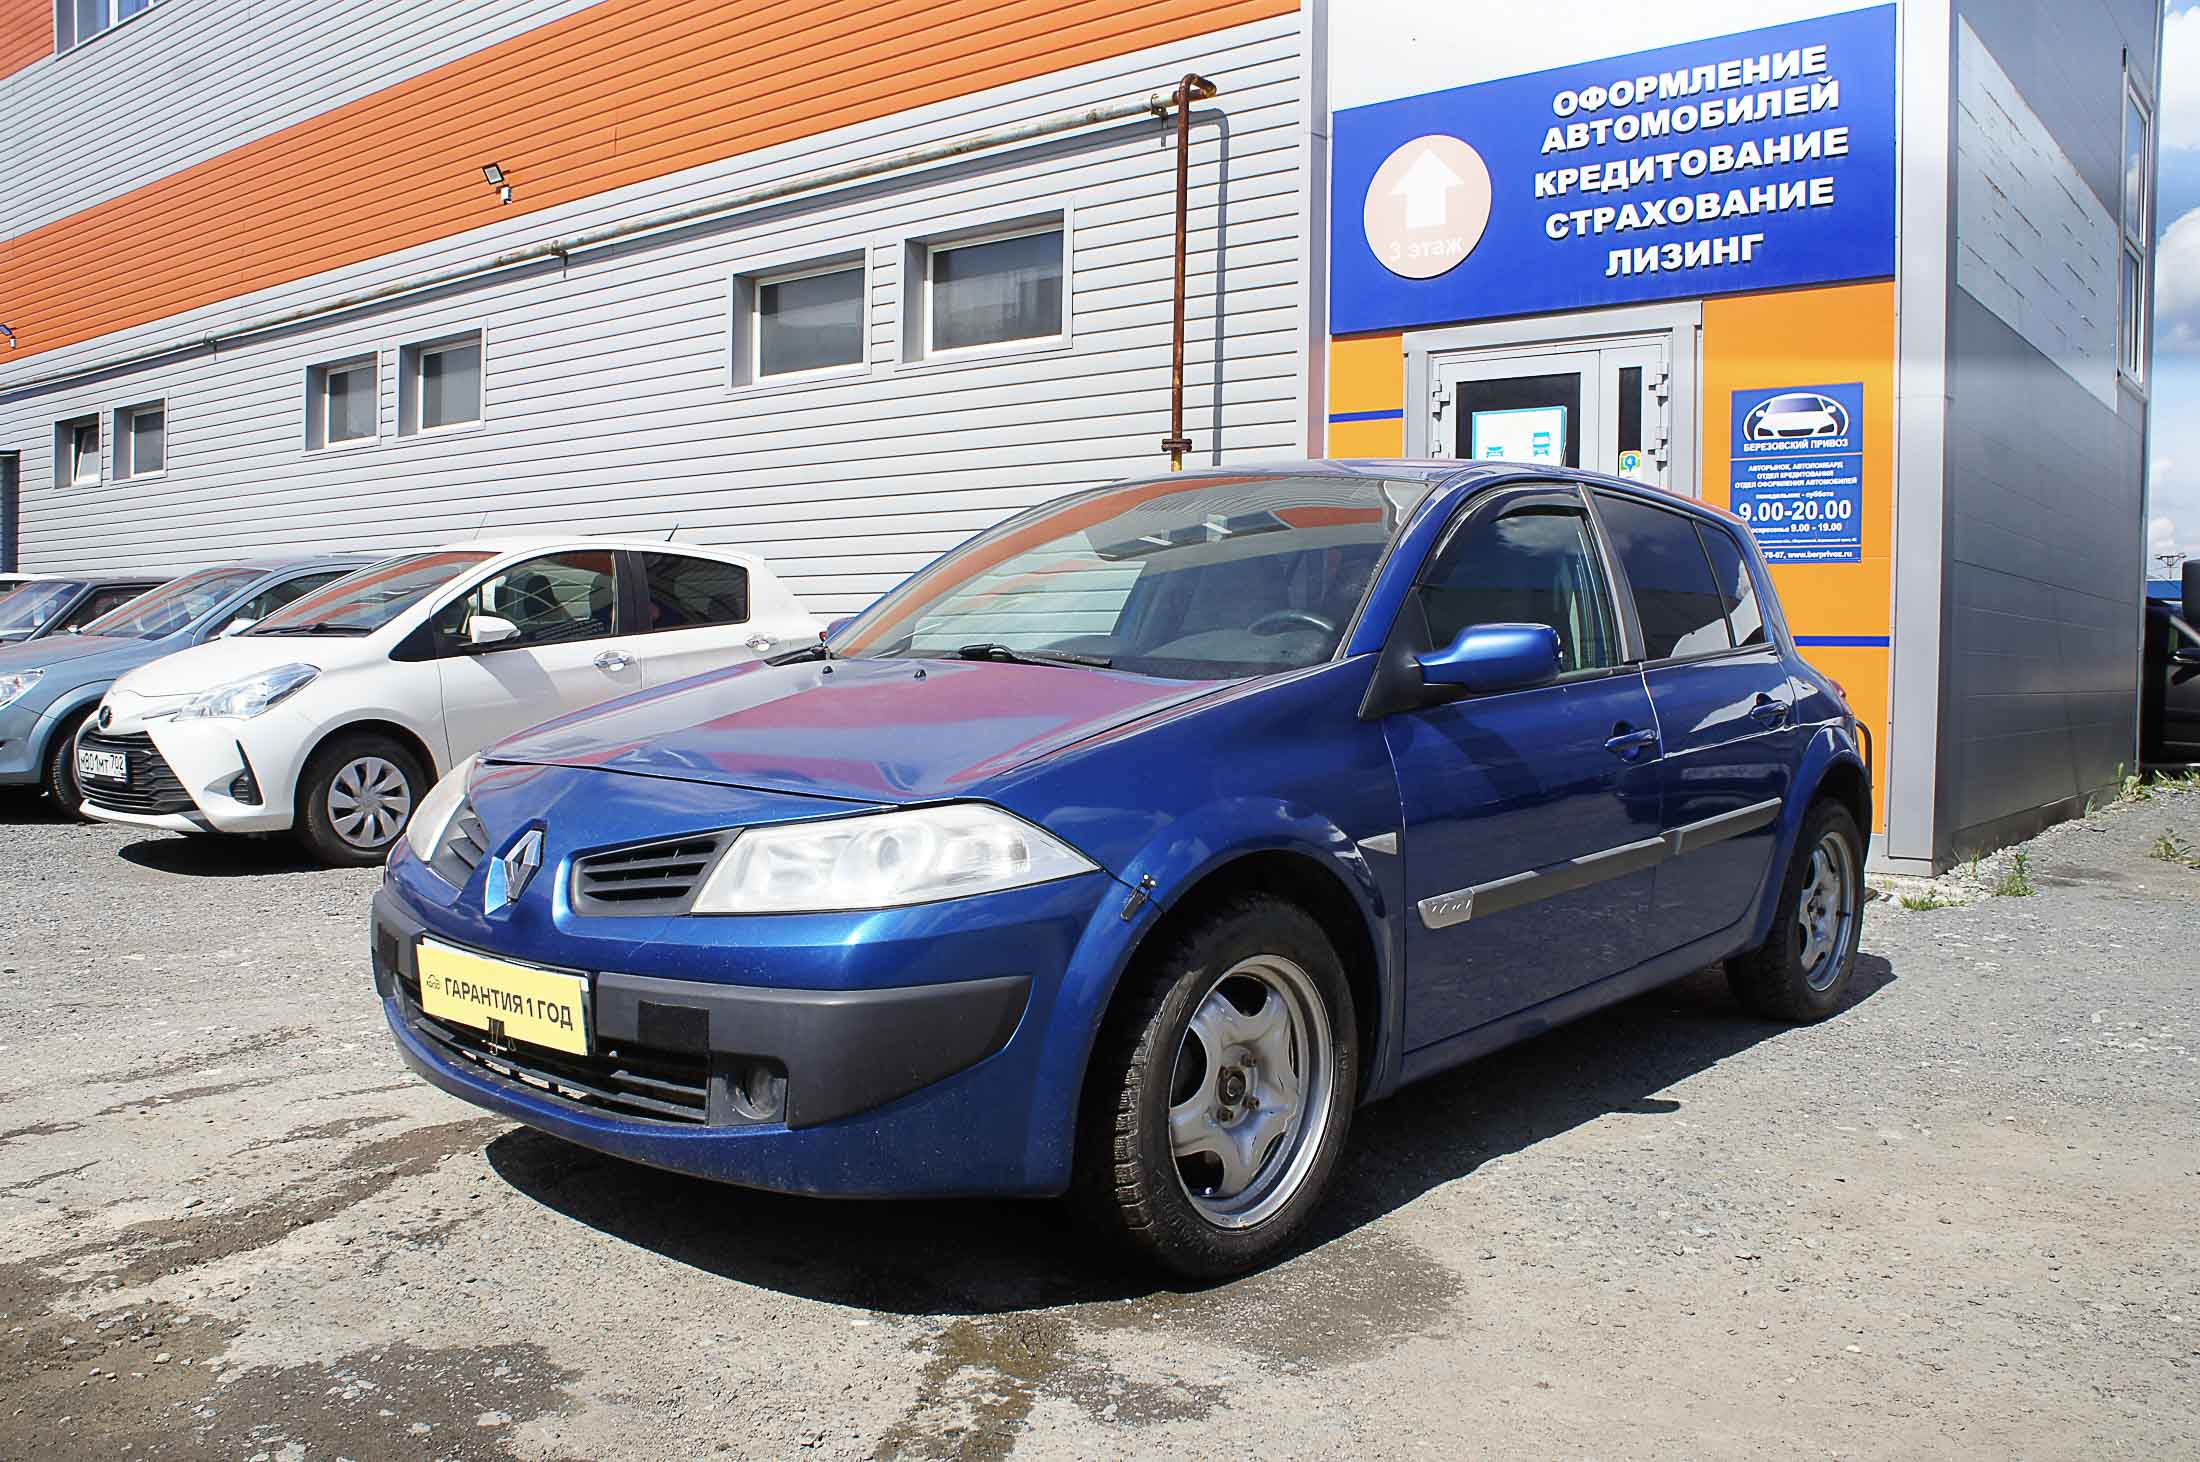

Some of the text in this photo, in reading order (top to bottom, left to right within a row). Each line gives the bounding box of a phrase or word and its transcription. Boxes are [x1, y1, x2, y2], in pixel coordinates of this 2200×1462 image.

[1552, 44, 1827, 118] ОФОРМЛЕНИЕ
[1541, 76, 1840, 154] АВТОМОБИЛЕЙ
[1534, 126, 1849, 198] КРЕДИТОВАНИЕ
[1545, 176, 1834, 239] СТРАХОВАНИЕ
[1408, 235, 1463, 260] этаж
[1605, 233, 1764, 277] ЛИЗИНГ
[1743, 438, 1848, 452] БЕРЕЗОВСКИЙ ПРИВОЗ
[1738, 500, 1852, 521] 9.00-20.00
[1790, 523, 1811, 532] 9.00
[1818, 522, 1843, 531] 19.00
[444, 977, 574, 1031] ГАРАНТИЯ 1 ГОД
